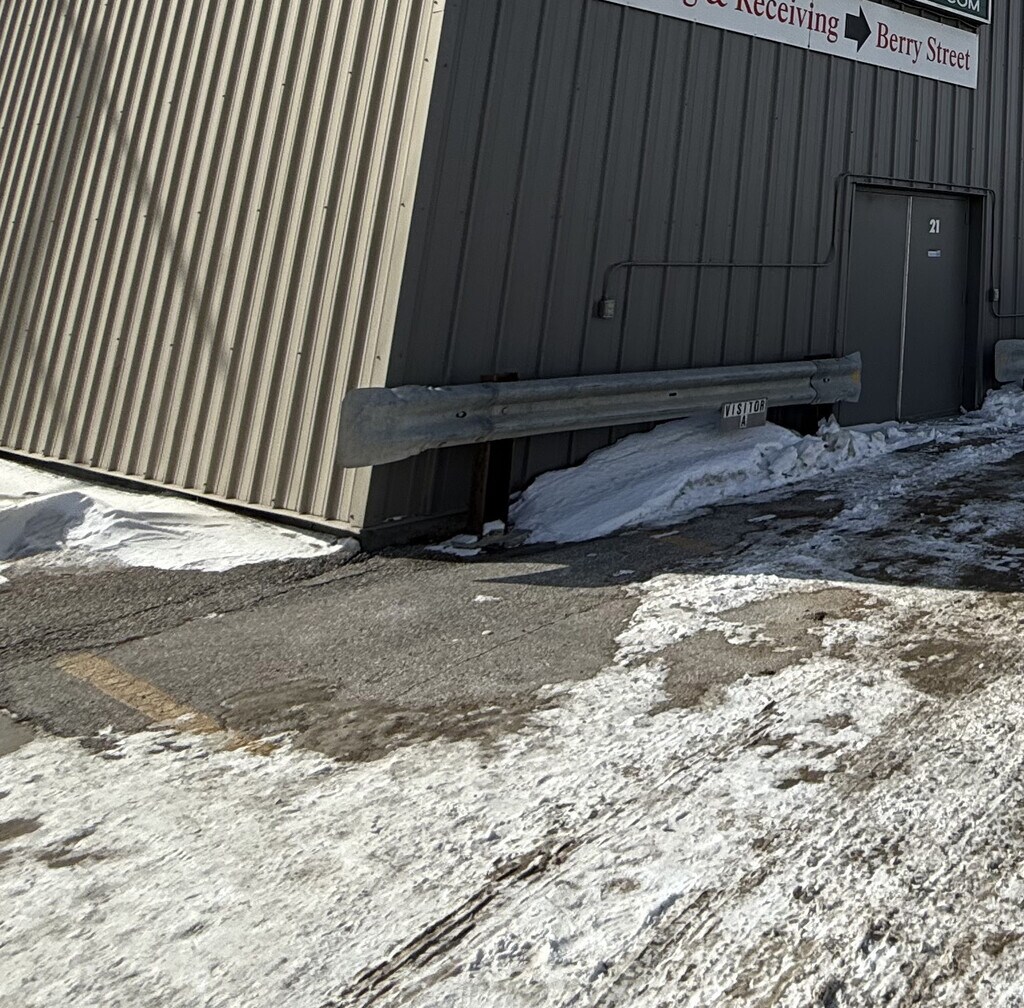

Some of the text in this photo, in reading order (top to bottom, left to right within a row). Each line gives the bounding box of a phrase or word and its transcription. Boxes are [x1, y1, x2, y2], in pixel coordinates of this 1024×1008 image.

[876, 21, 923, 64] Berry
[926, 36, 972, 71] Street
[929, 218, 940, 233] 21
[724, 399, 766, 417] VISITOR
